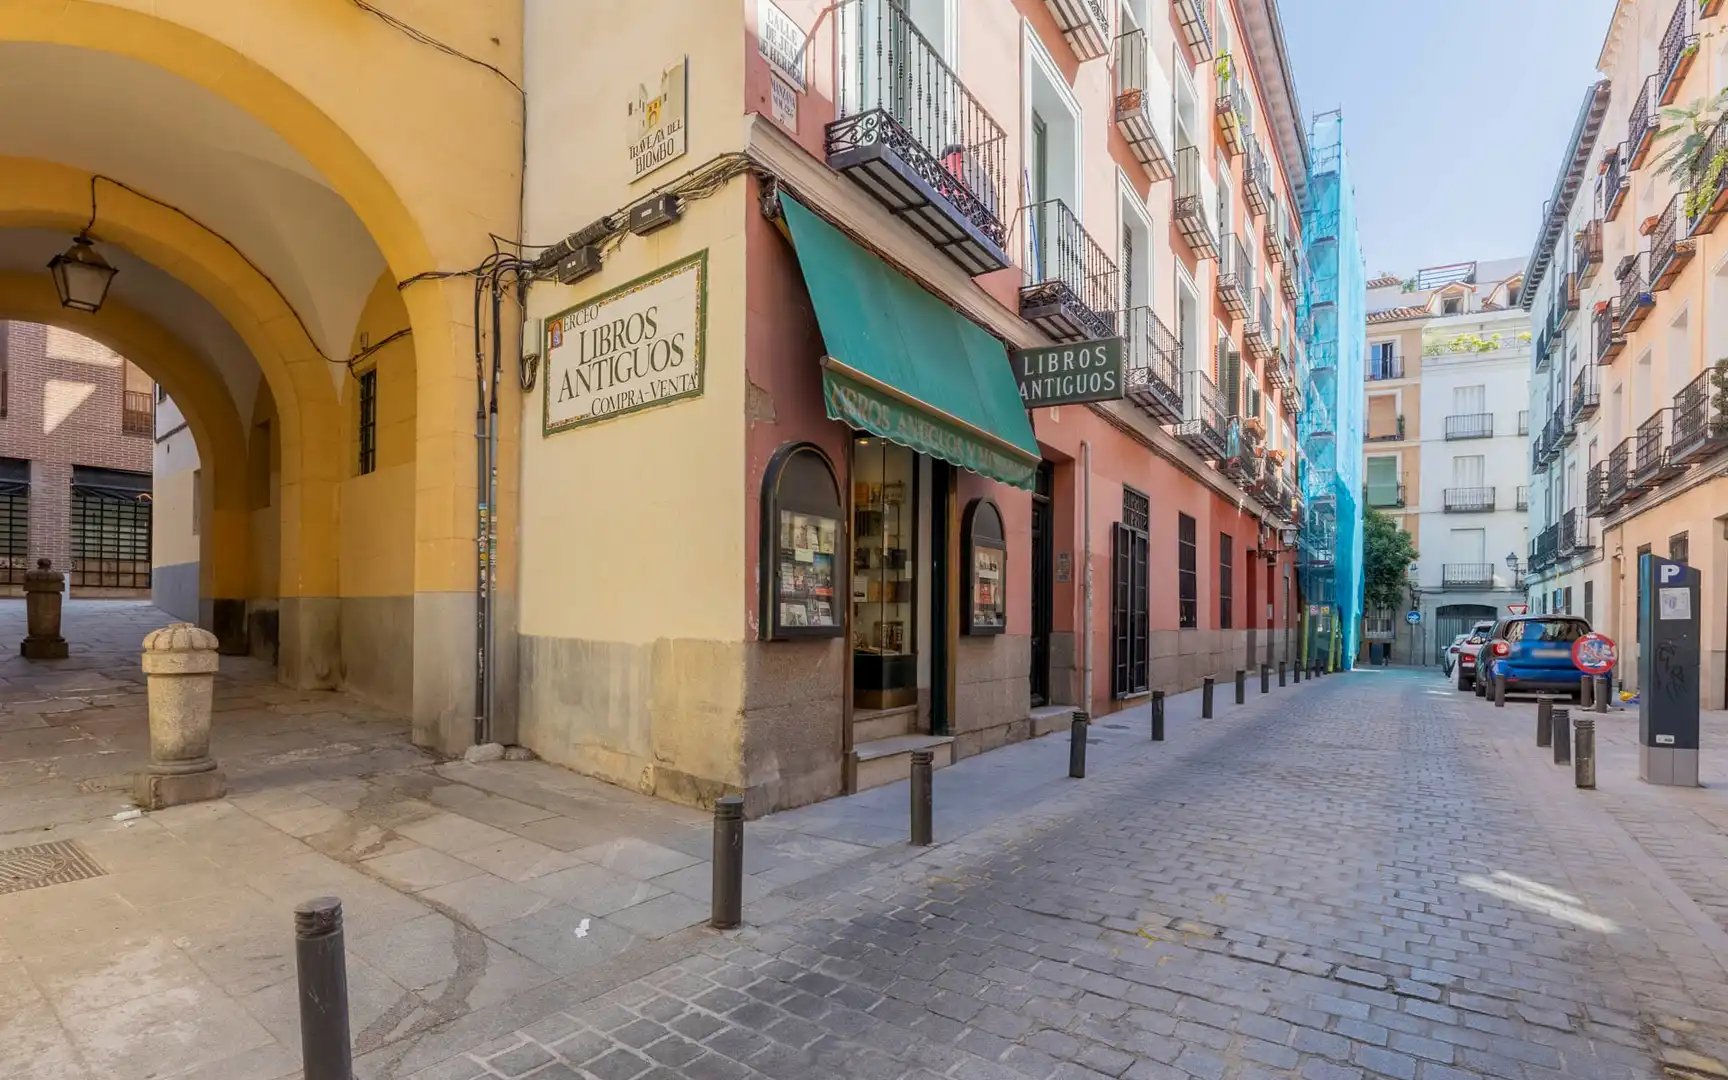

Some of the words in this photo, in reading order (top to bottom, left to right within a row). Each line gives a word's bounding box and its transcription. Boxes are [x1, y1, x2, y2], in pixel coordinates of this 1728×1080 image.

[667, 119, 683, 136] DEL
[635, 138, 674, 175] BIOMBO
[578, 306, 658, 367] LIBROS
[557, 332, 685, 403] ANTIGUOS
[1024, 346, 1107, 376] LIBROS
[591, 373, 698, 416] COMPRA-VENTA
[1020, 370, 1116, 400] ANTIGUOS
[1660, 564, 1680, 583] P
